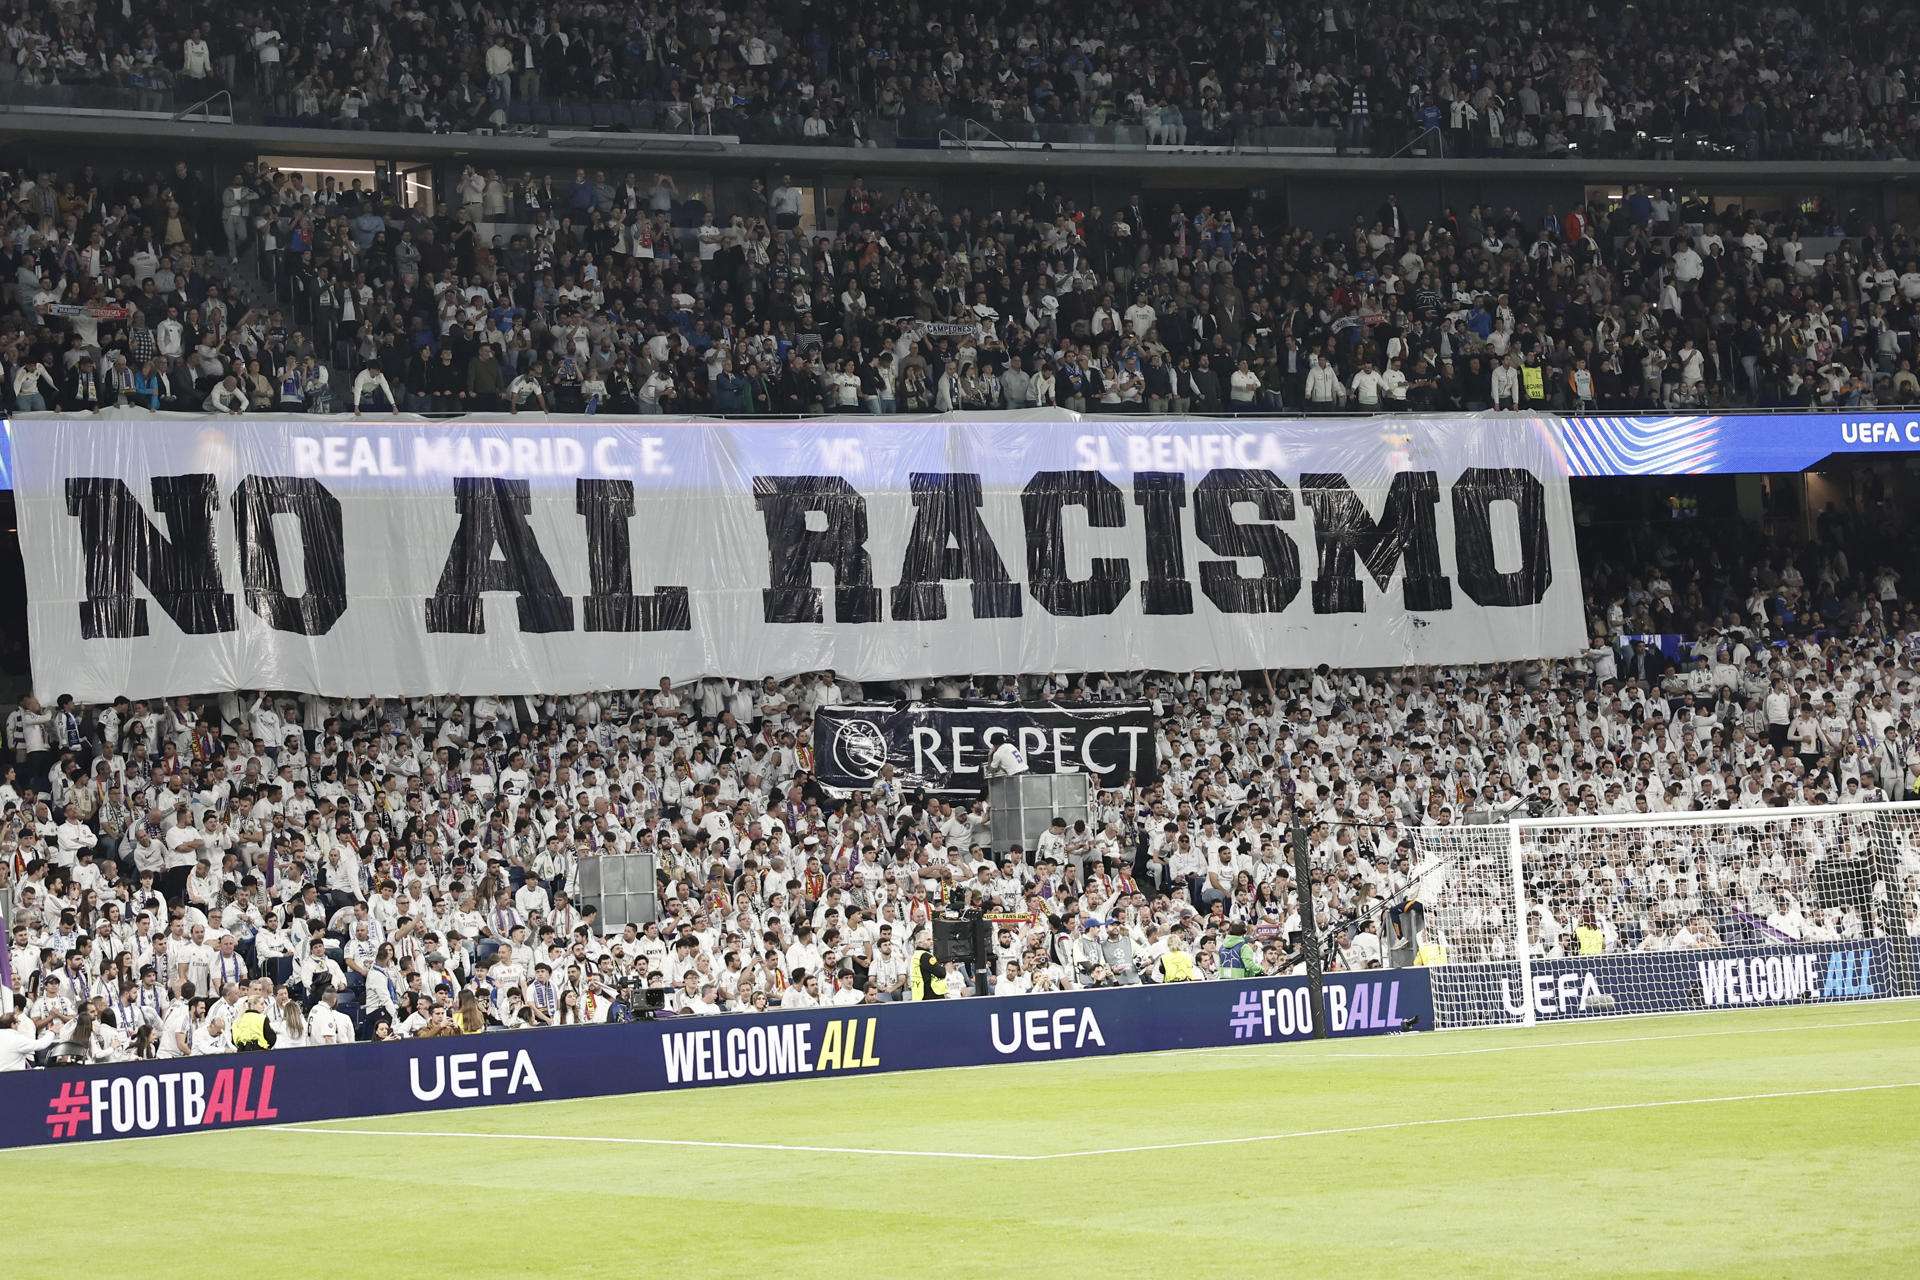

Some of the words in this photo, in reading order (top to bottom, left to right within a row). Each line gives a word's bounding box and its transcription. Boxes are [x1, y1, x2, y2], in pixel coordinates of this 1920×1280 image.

[817, 437, 864, 472] VS
[1076, 435, 1121, 471] SL
[1129, 433, 1288, 470] BENFICA
[1841, 422, 1900, 443] UEFA
[1905, 421, 1920, 443] C
[294, 437, 405, 476] REAL
[414, 436, 583, 475] MADRID
[65, 473, 348, 641] NO
[425, 477, 692, 635] AL
[753, 467, 1553, 625] RACISMO
[1502, 972, 1602, 1015] UEFA
[1698, 954, 1820, 1004] WELCOME
[1823, 949, 1873, 997] ALL
[662, 1023, 814, 1083] WELCOME
[816, 1018, 881, 1070] ALL
[990, 1007, 1106, 1054] UEFA
[410, 1049, 543, 1102] UEFA
[46, 1066, 278, 1138] #FOOTBALL
